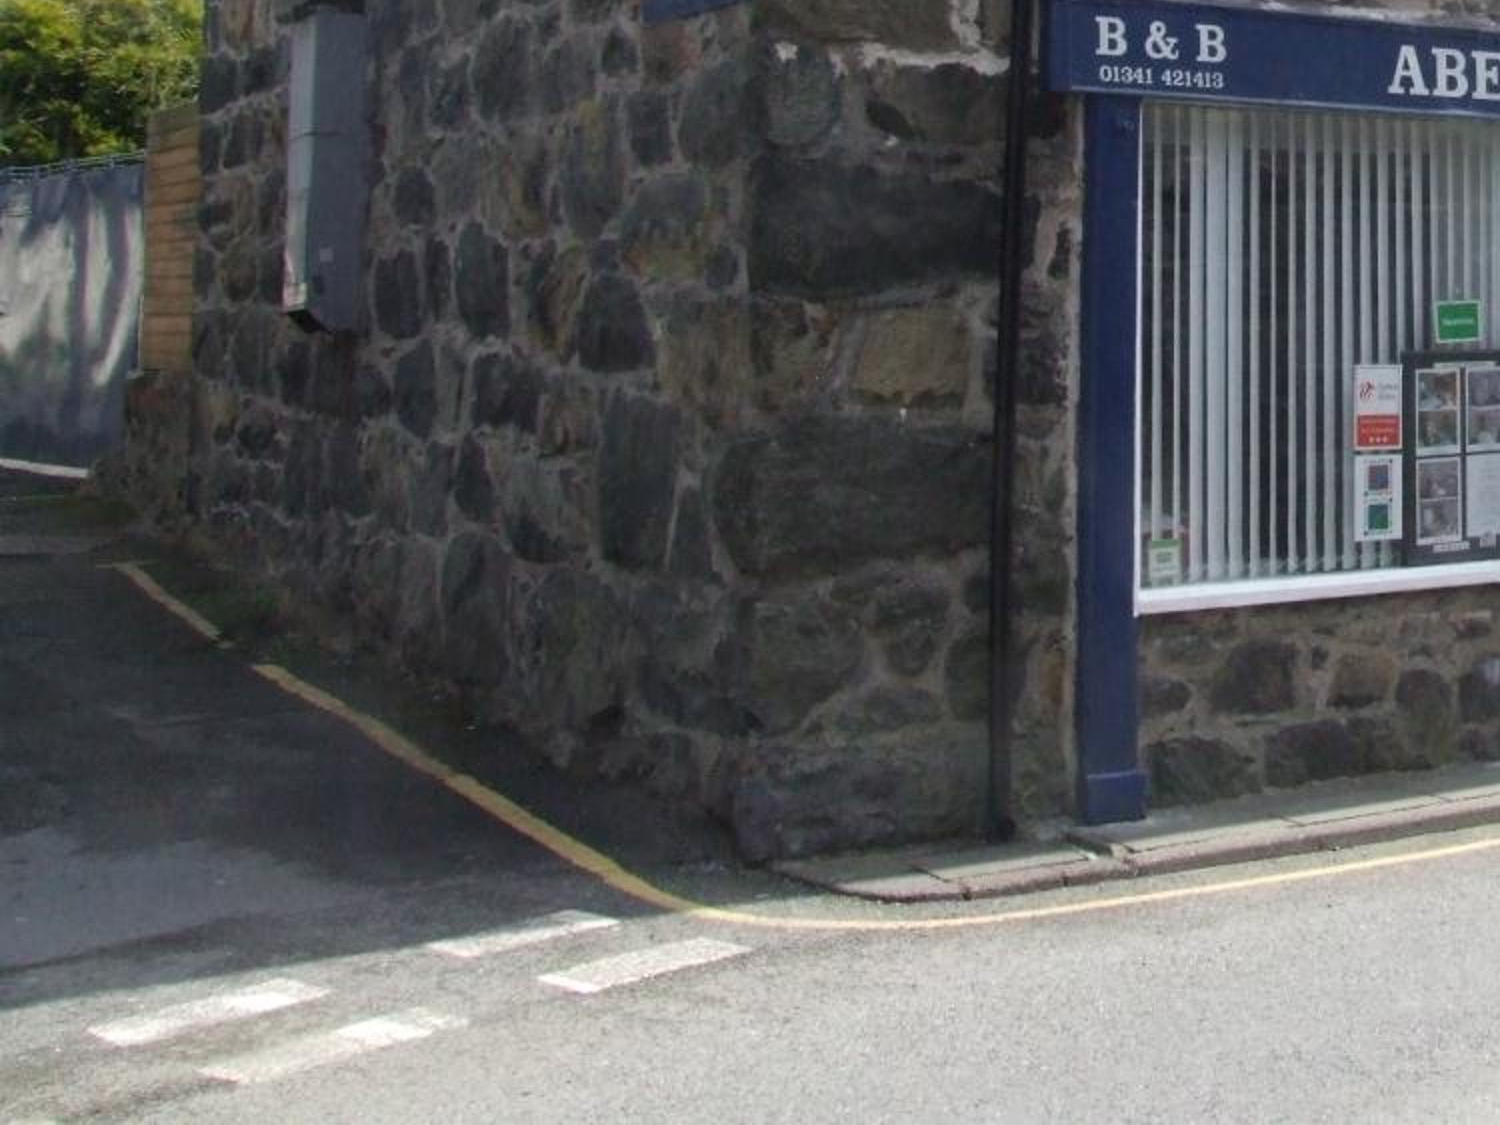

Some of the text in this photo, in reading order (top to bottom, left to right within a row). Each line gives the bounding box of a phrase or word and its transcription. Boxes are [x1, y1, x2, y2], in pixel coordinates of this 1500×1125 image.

[1094, 16, 1228, 63] B & B
[1099, 64, 1224, 90] 01341 421413
